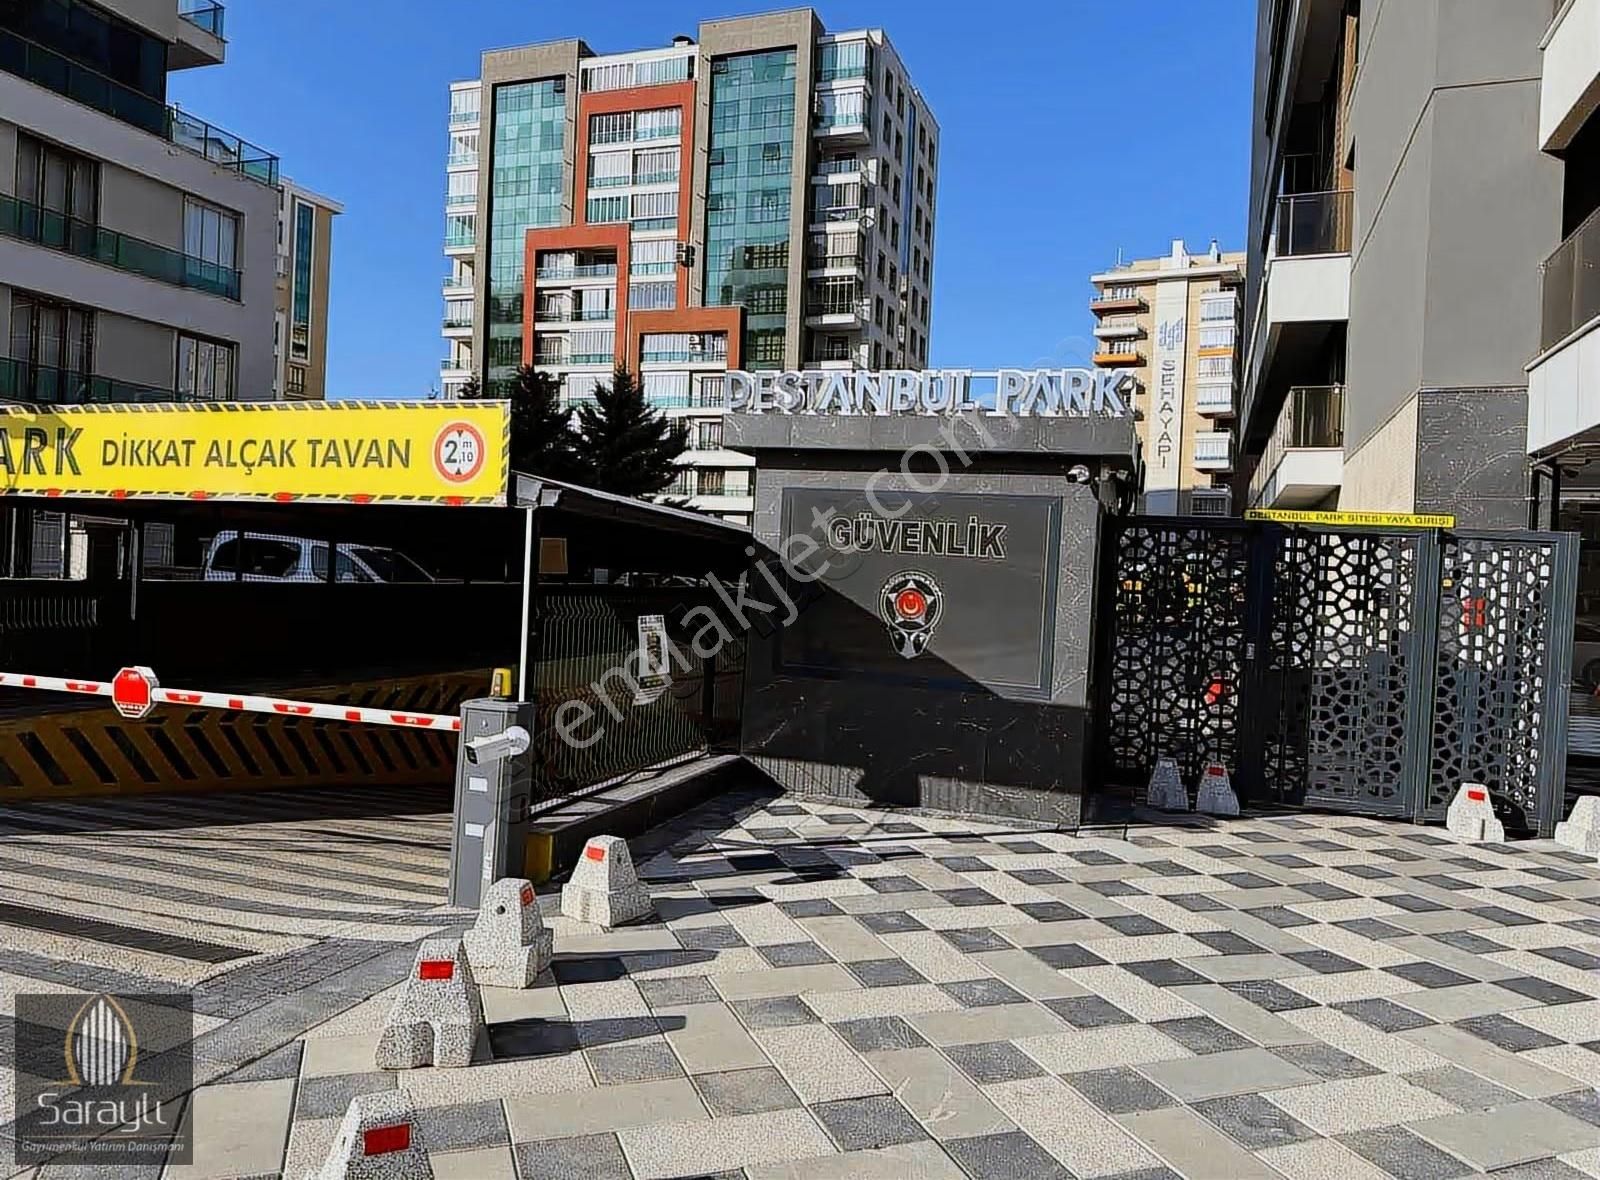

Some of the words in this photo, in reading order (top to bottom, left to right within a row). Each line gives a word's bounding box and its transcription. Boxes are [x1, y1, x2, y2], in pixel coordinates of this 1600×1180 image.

[724, 370, 979, 415] DESTANBUL
[997, 369, 1133, 416] PARK
[102, 431, 196, 467] DİKKAT
[204, 438, 297, 475] ALÇAK
[307, 438, 411, 469] TAVAN
[827, 511, 1007, 560] GÜVENLİK
[1385, 515, 1412, 524] YAYA
